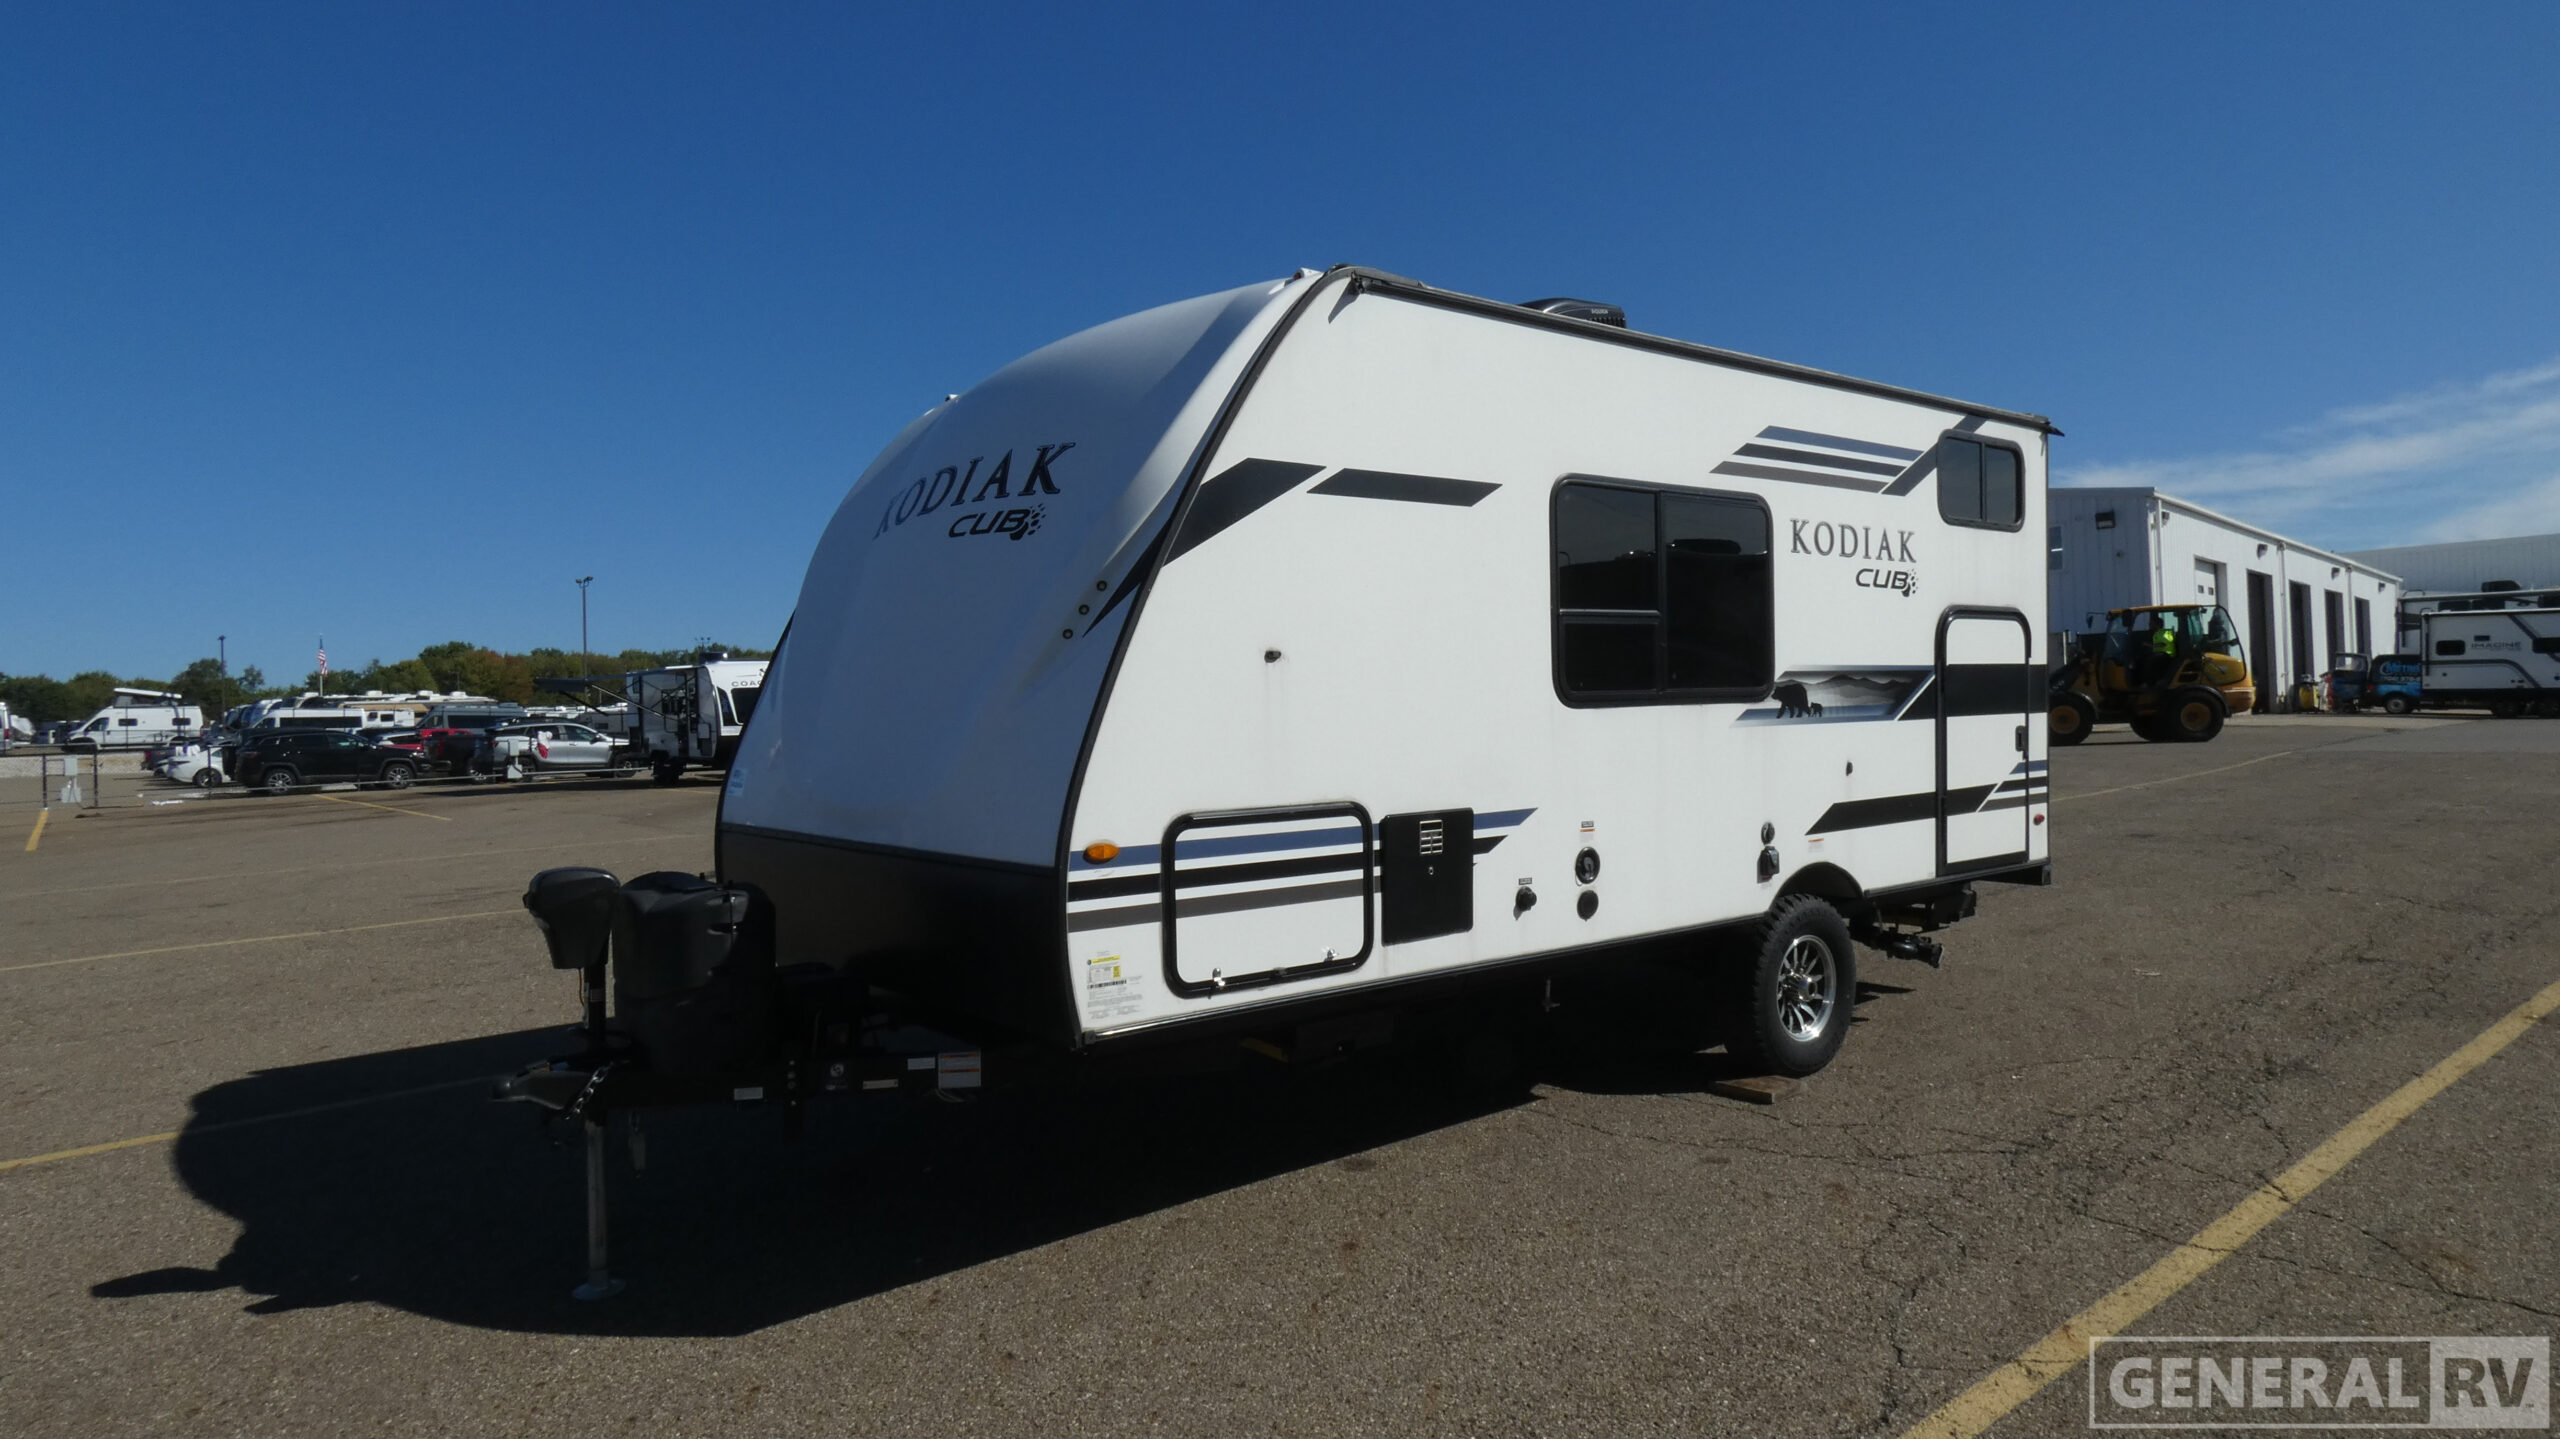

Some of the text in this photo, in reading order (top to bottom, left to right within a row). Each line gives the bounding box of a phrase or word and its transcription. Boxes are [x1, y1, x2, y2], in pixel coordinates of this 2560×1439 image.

[872, 441, 1077, 541] KODIAK
[948, 508, 1031, 538] CUB
[1790, 518, 1917, 563] KODIAK
[1855, 568, 1910, 591] CUB
